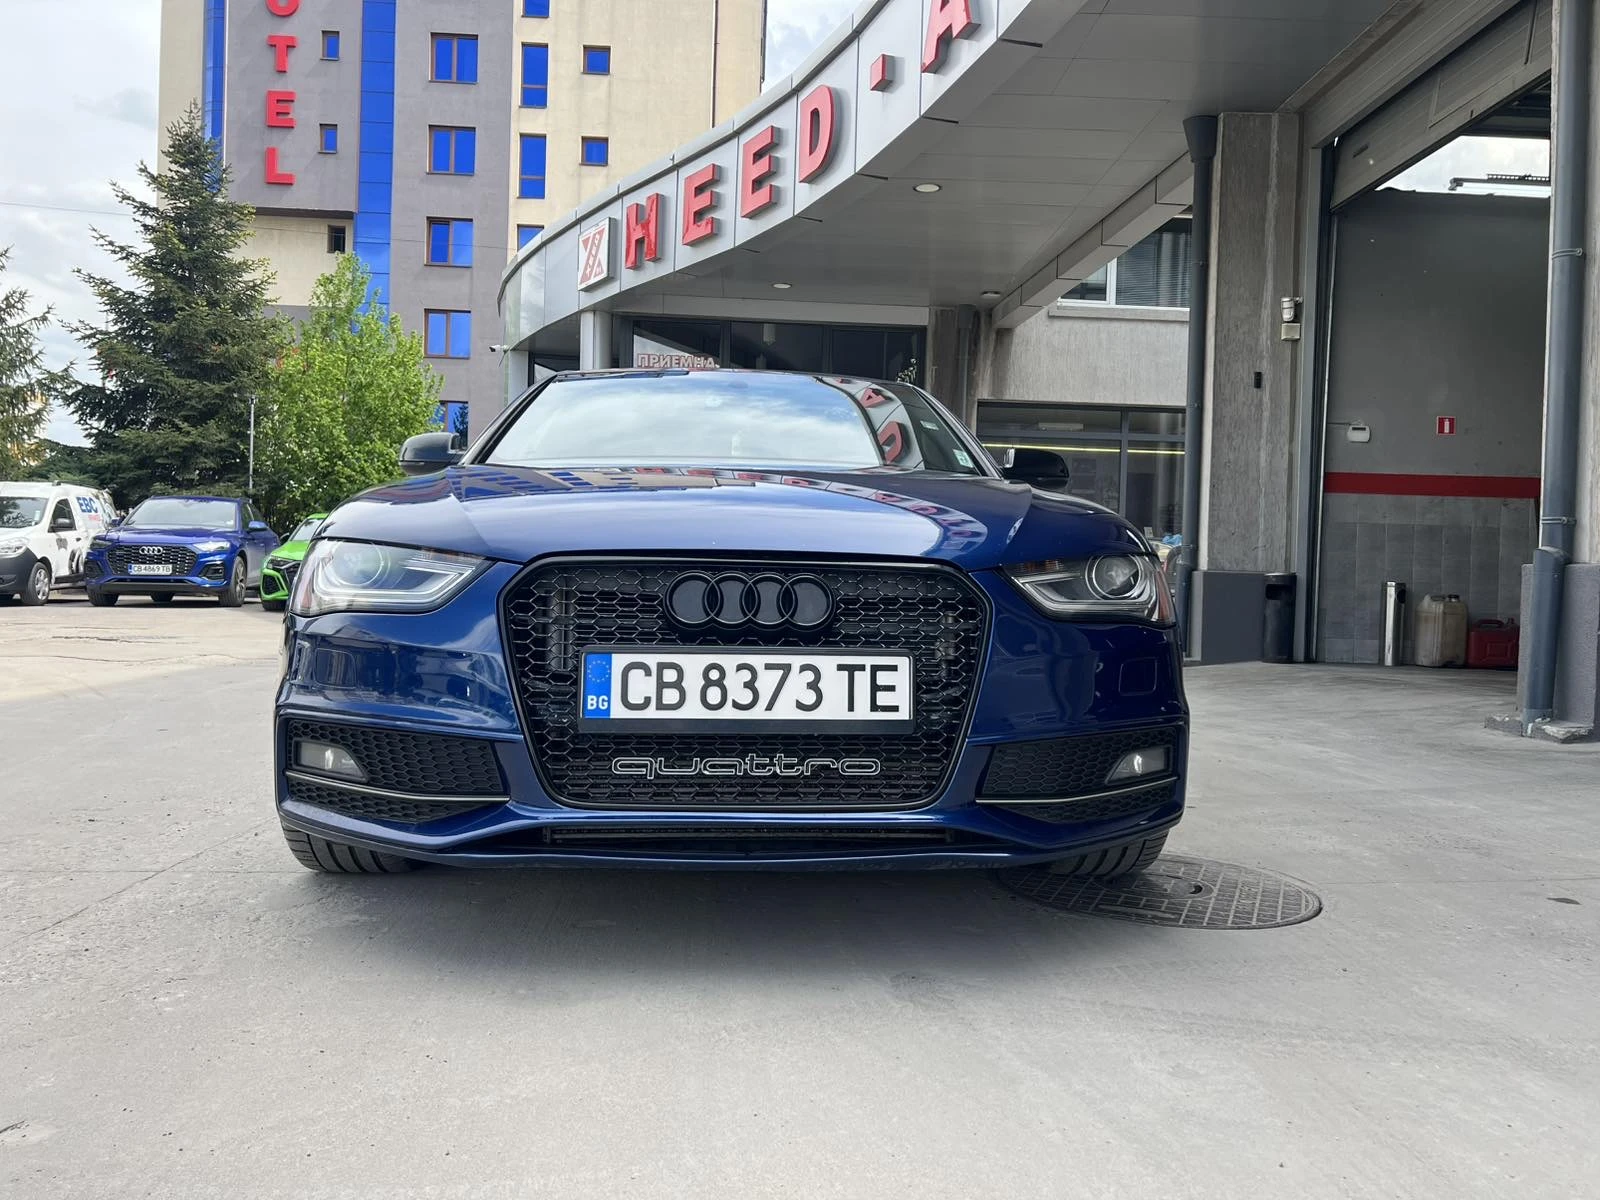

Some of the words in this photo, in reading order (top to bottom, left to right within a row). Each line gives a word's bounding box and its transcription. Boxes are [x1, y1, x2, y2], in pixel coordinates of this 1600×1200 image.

[637, 353, 716, 369] ПРИЕМНА
[76, 496, 98, 513] EBC
[587, 695, 608, 710] BG
[620, 661, 686, 711] CB
[699, 662, 823, 712] 8373
[836, 663, 900, 713] TE
[612, 753, 881, 779] quattro
